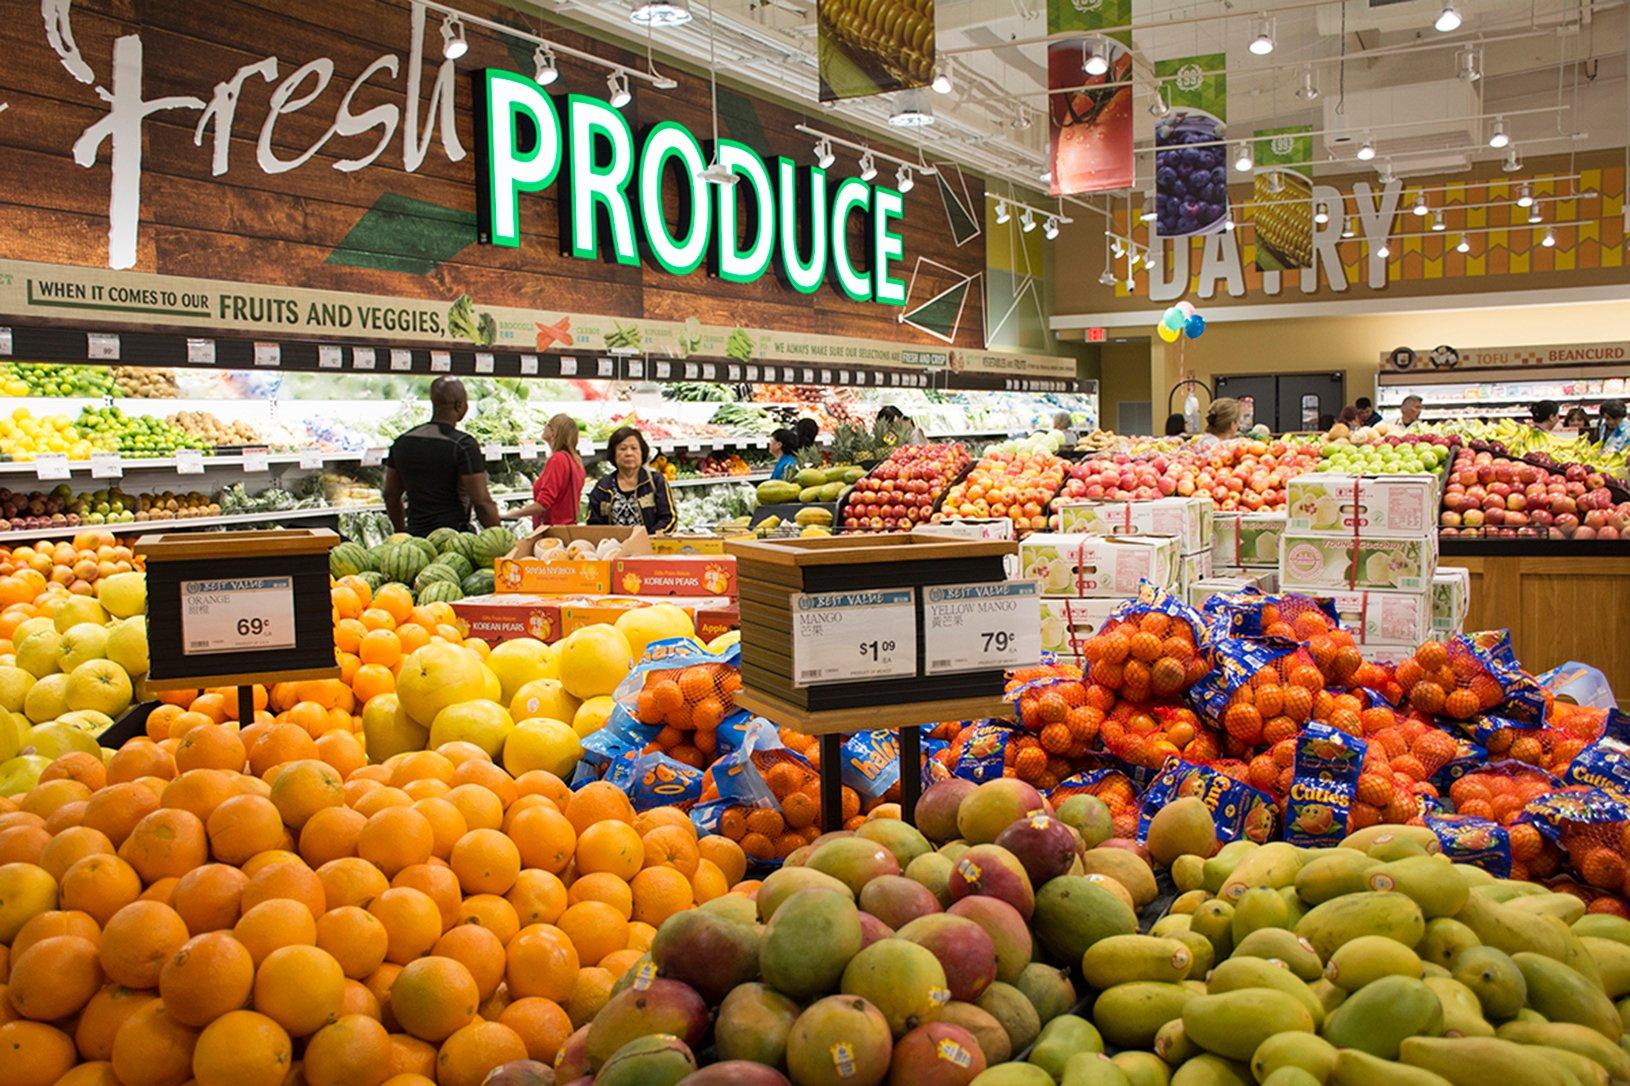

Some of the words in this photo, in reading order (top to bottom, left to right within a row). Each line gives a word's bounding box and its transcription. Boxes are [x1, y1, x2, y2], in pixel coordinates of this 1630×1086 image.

[485, 67, 907, 306] PRODUCE
[1149, 180, 1403, 302] DARY
[39, 281, 86, 299] WHEN
[91, 285, 104, 300] IT
[108, 287, 158, 304] COMES
[160, 291, 178, 306] TO
[181, 293, 209, 309] OUR
[219, 294, 299, 325] FRUITS
[306, 302, 353, 328] AND
[357, 306, 446, 338] VEGGIES,
[774, 342, 785, 353] WE
[786, 343, 809, 355] ALWAYS
[811, 344, 828, 356] MAKE
[829, 345, 844, 357] SURE
[1548, 347, 1625, 362] BEANCURD
[1476, 353, 1509, 365] TOFU
[230, 580, 264, 590] VALUE
[644, 577, 674, 586] KOREAN
[675, 577, 699, 586] PEARS
[945, 587, 971, 599] BEST
[975, 585, 1010, 598] VALUE
[187, 594, 231, 605] ORANGE
[816, 596, 843, 608] BEST
[846, 592, 884, 606] VALUE
[930, 603, 974, 616] YELLOW
[977, 600, 1017, 614] MANGO
[799, 612, 843, 625] MANGO
[473, 621, 501, 631] KOREAN
[502, 622, 524, 632] PEARS
[701, 624, 728, 634] Apple
[1290, 783, 1351, 807] Cuties
